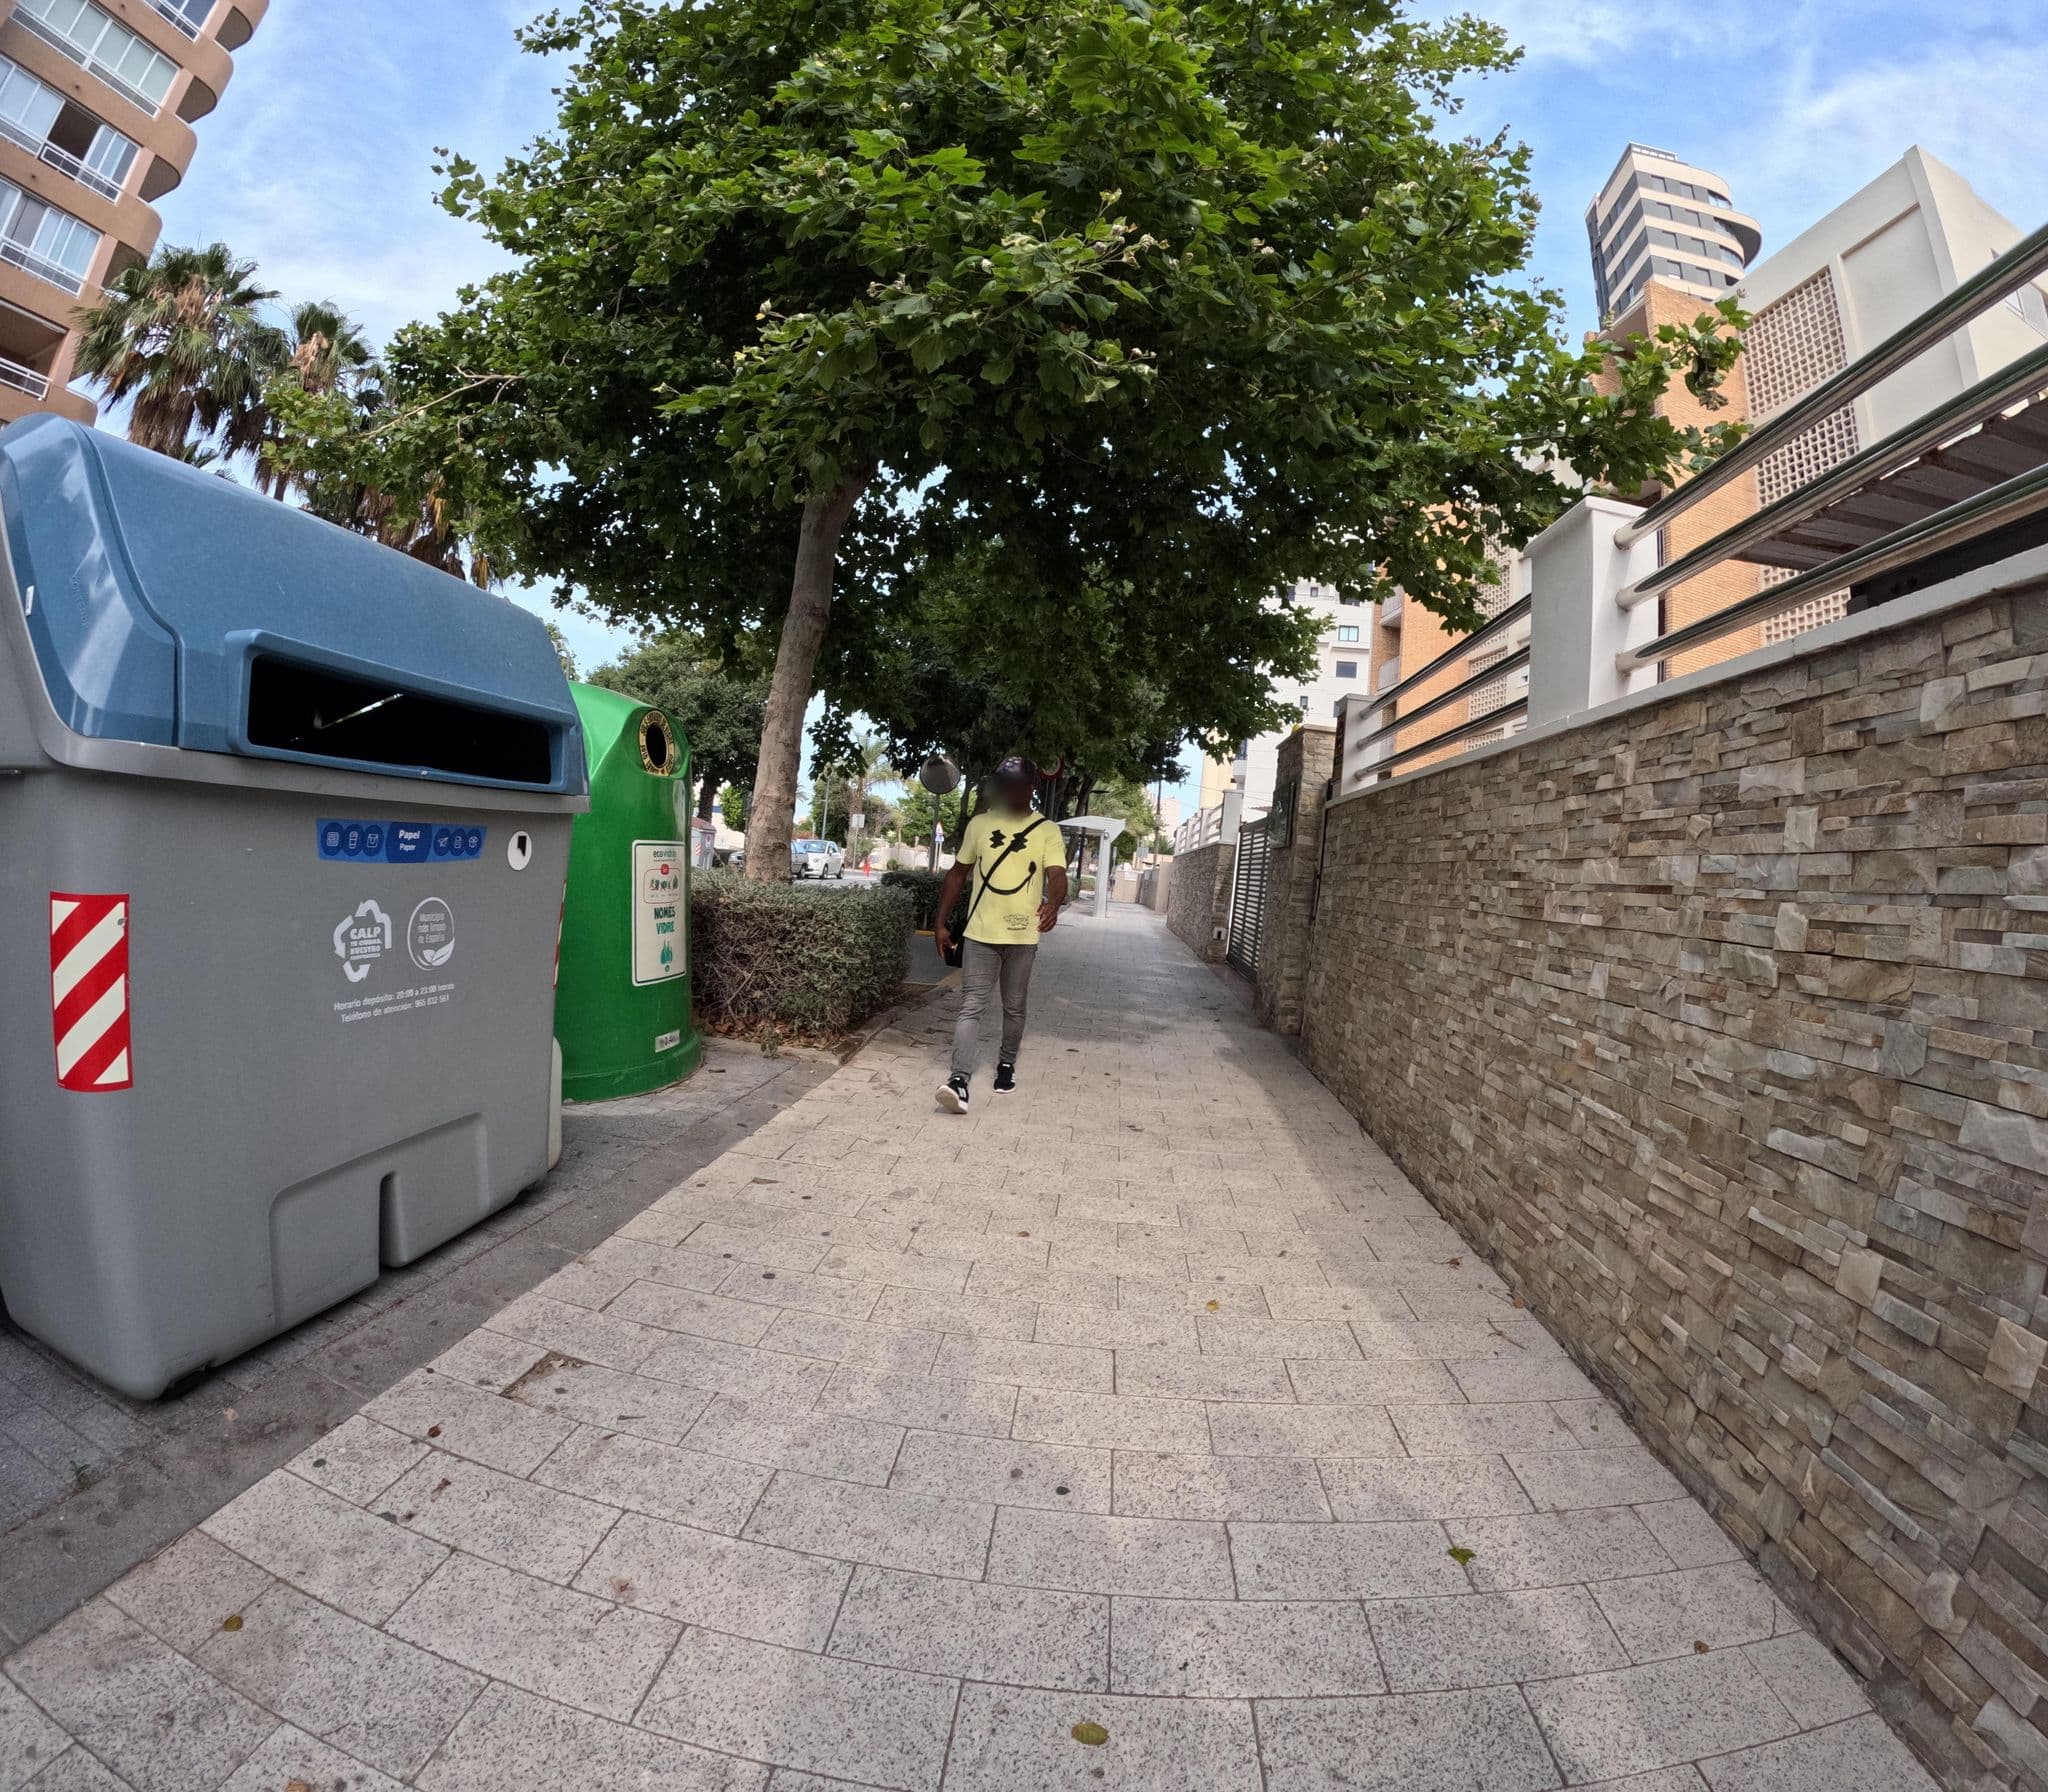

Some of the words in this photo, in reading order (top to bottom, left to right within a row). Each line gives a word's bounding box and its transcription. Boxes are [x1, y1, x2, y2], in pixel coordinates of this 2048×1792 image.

[399, 829, 420, 840] Papel
[350, 927, 381, 940] CALP
[333, 999, 361, 1012] Horario
[341, 1008, 372, 1023] Teléfono
